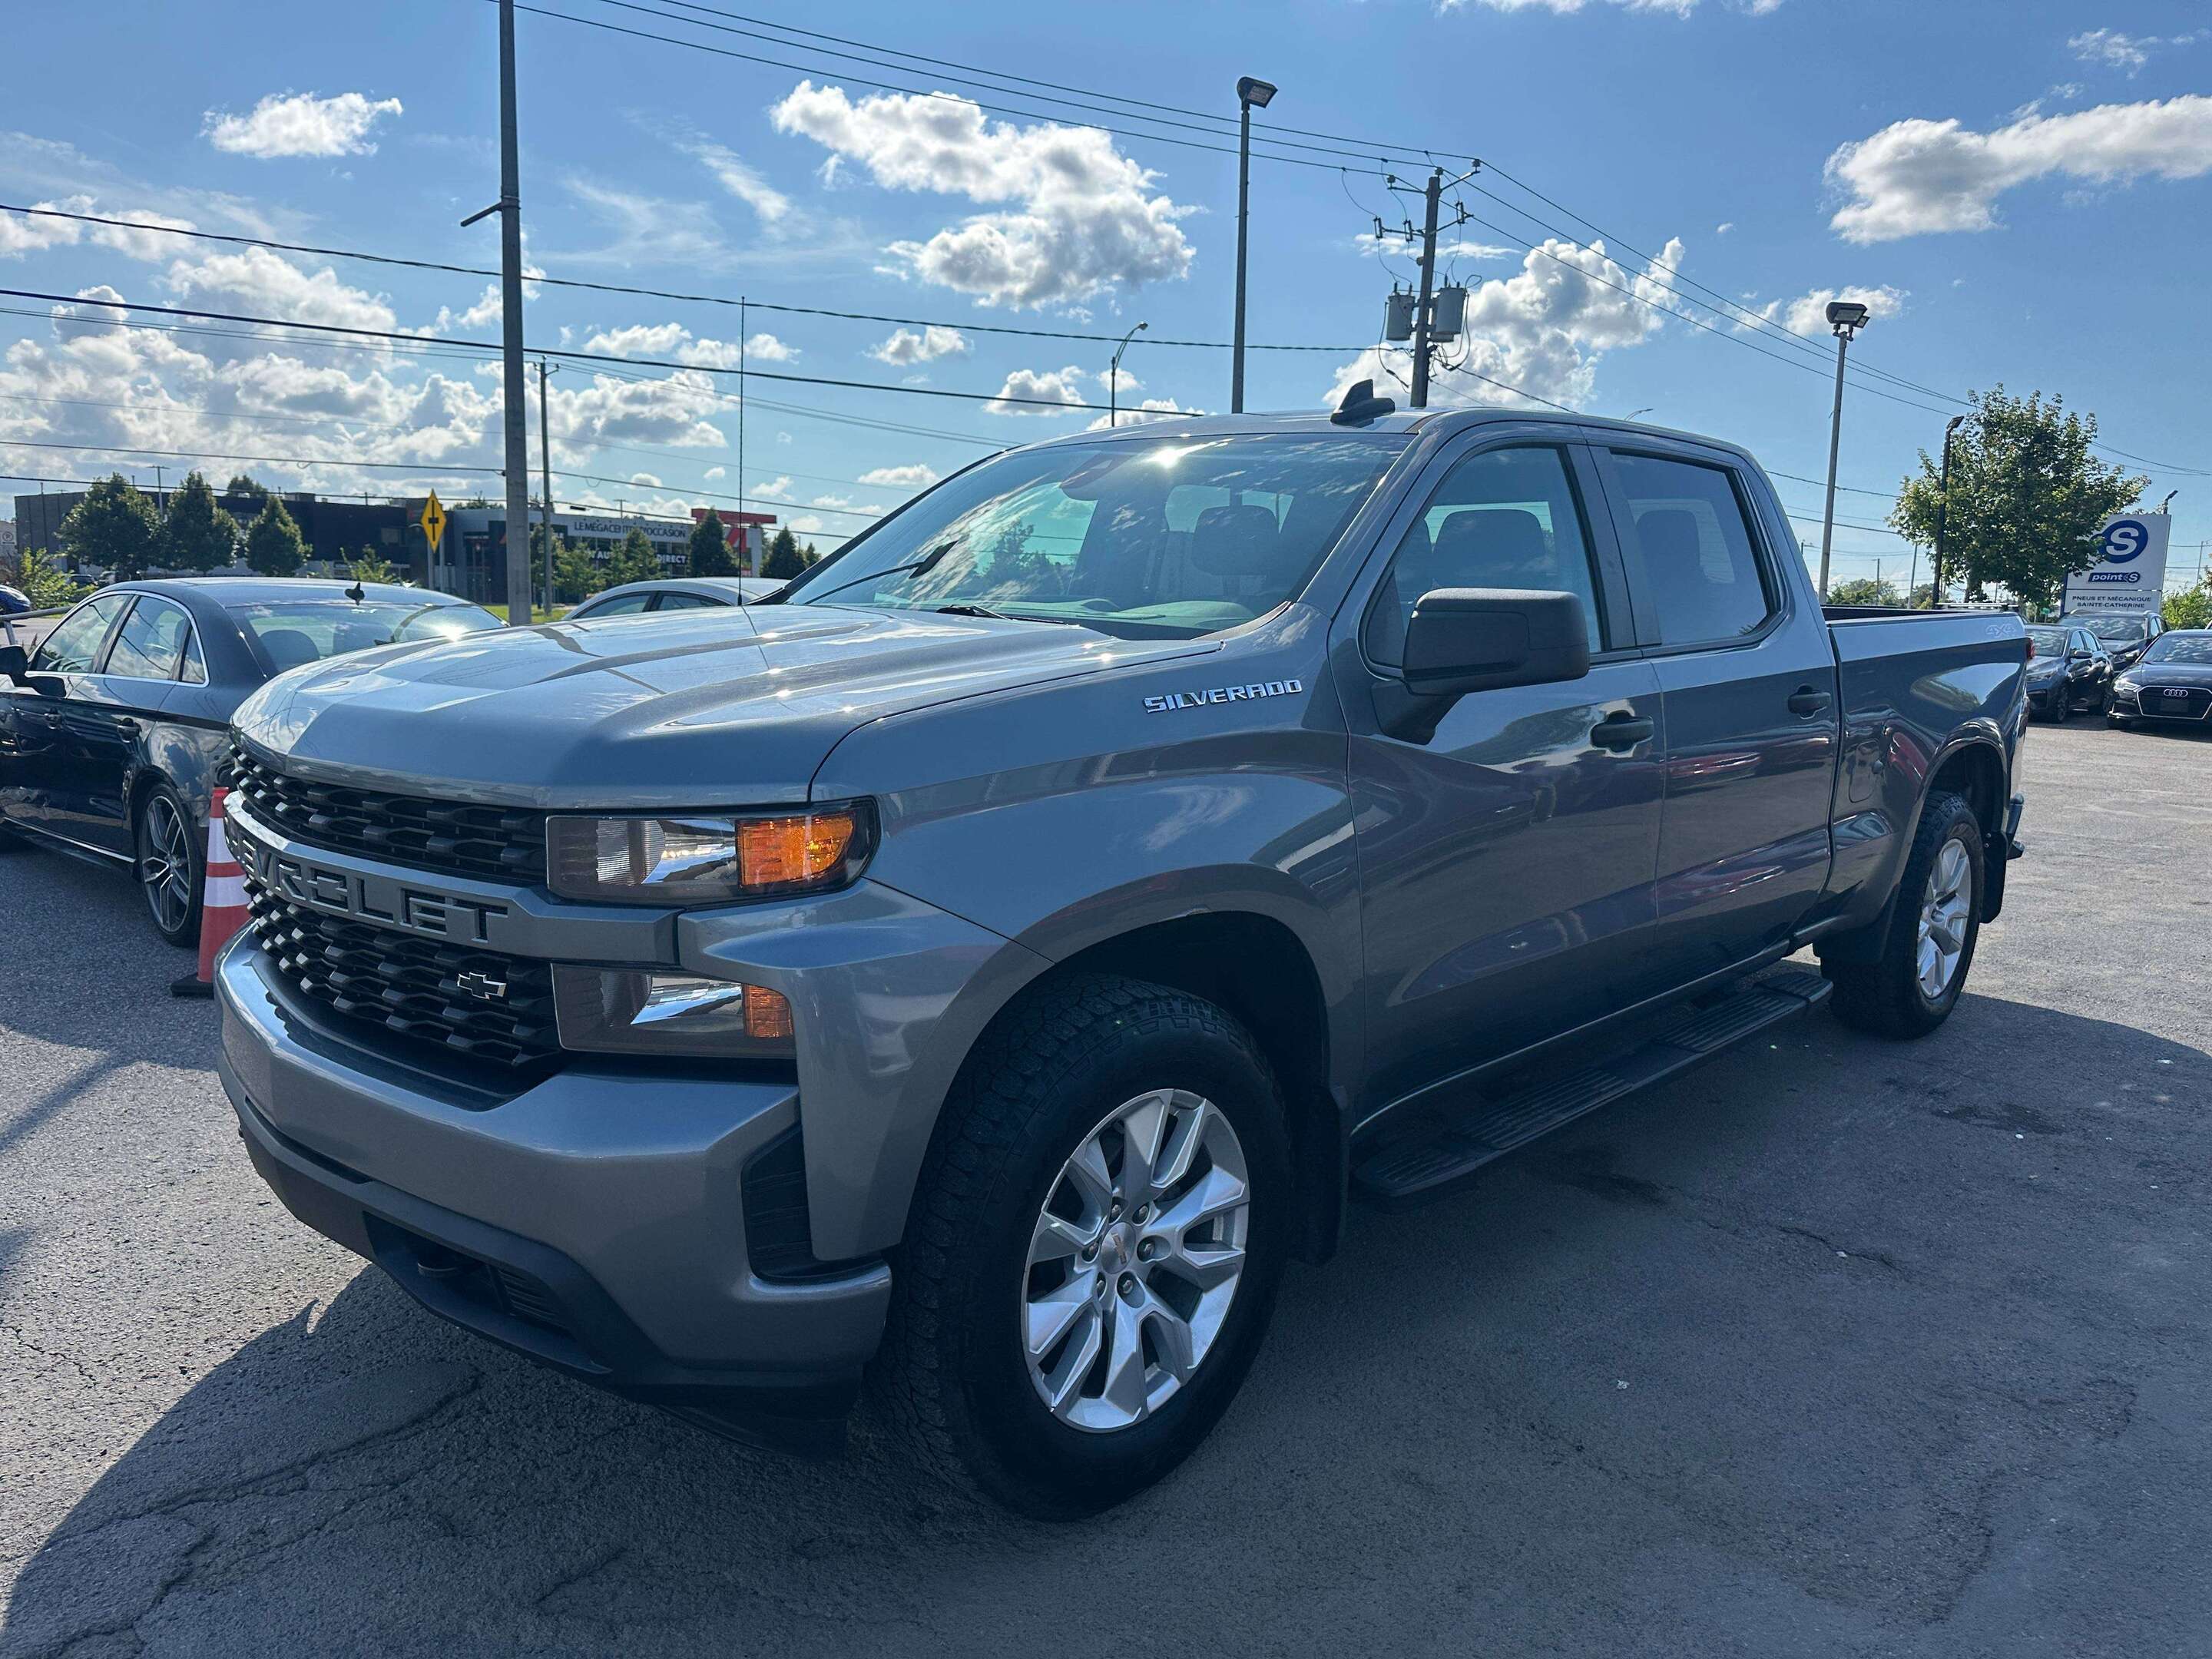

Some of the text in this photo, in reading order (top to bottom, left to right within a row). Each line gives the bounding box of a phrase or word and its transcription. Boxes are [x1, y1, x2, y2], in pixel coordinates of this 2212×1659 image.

[2106, 527, 2139, 556] S
[2091, 573, 2123, 582] point
[1144, 679, 1303, 714] SILVERADO
[224, 816, 509, 944] EVROLET
